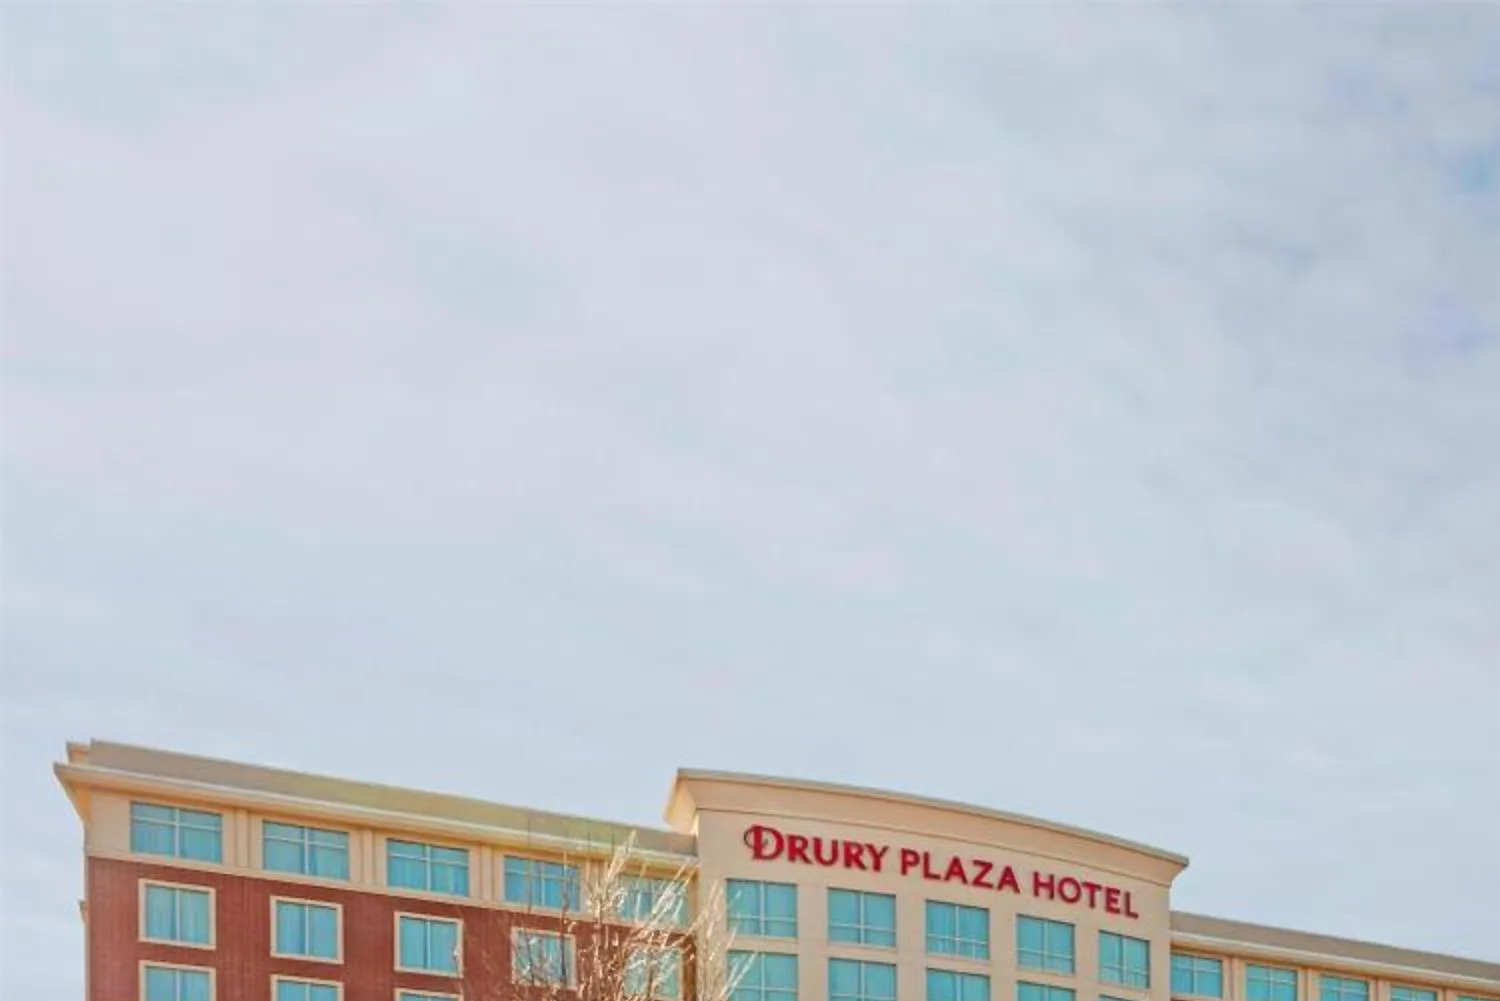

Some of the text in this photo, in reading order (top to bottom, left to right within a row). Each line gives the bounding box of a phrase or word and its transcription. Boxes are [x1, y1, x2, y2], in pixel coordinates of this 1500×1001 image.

[743, 825, 1139, 919] DRURY PLAZA HOTEL
